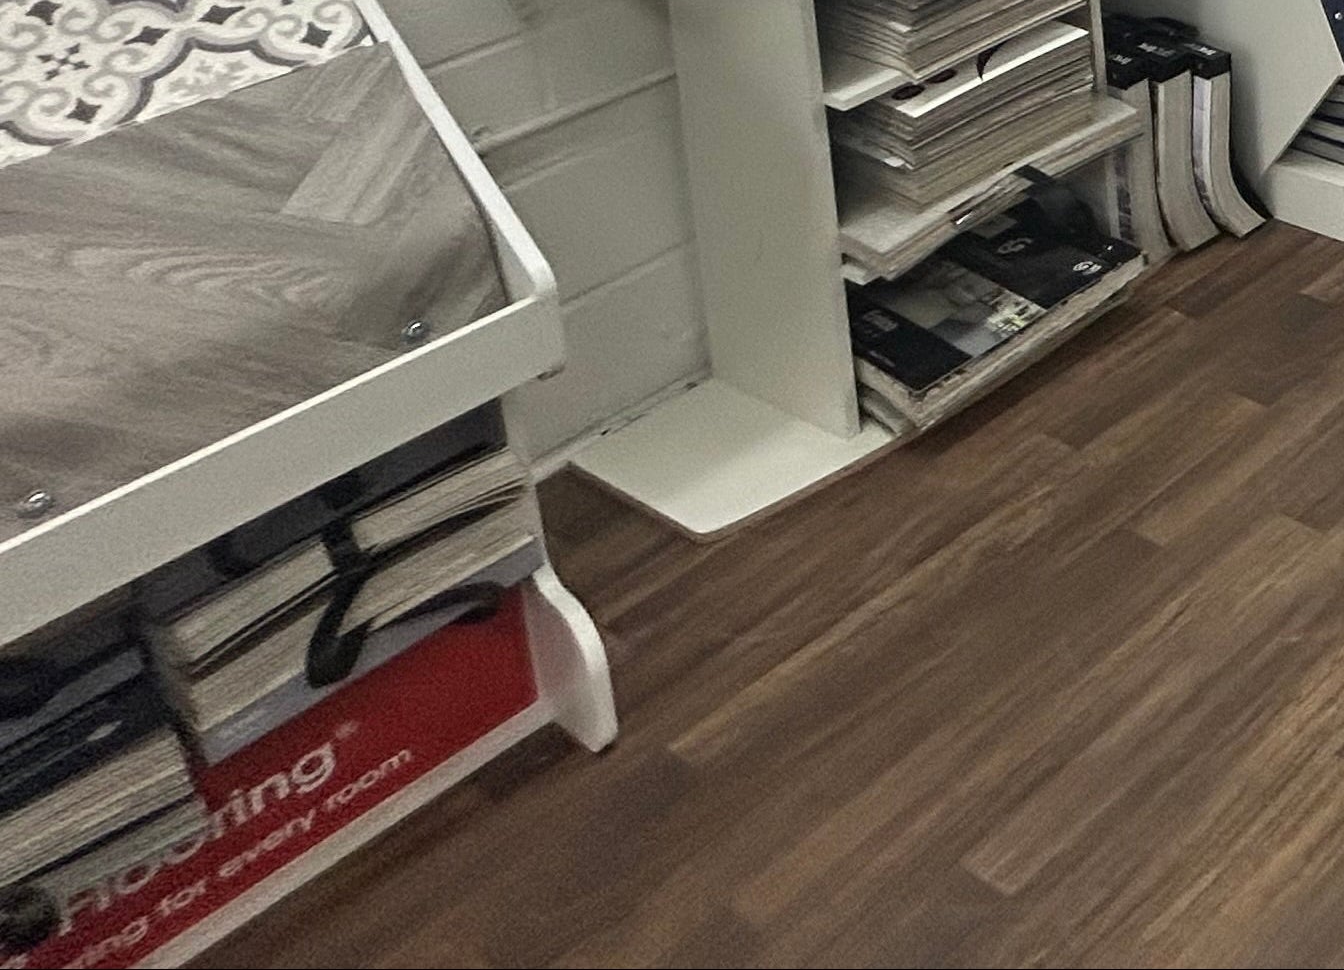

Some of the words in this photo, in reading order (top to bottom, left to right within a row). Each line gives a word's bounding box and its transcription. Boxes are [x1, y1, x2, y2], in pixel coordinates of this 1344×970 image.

[155, 879, 207, 917] for
[218, 808, 317, 879] every
[323, 747, 412, 814] room
